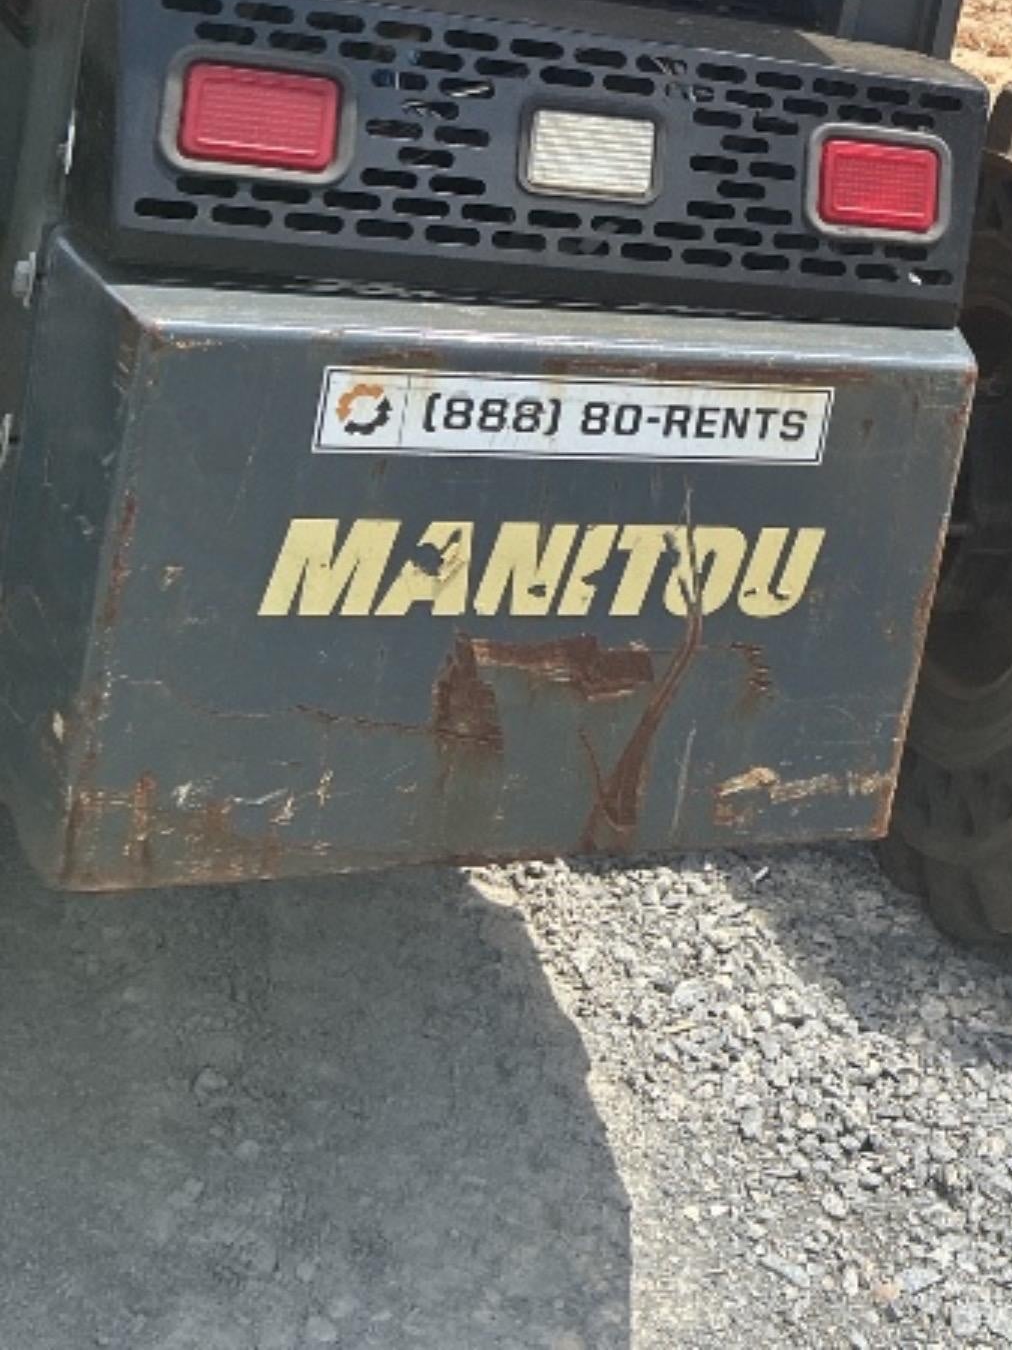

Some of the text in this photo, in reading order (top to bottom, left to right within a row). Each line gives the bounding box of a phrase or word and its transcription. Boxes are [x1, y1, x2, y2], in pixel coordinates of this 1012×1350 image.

[422, 392, 808, 441] (888) 80-RENTS
[257, 518, 826, 618] MANITOU
